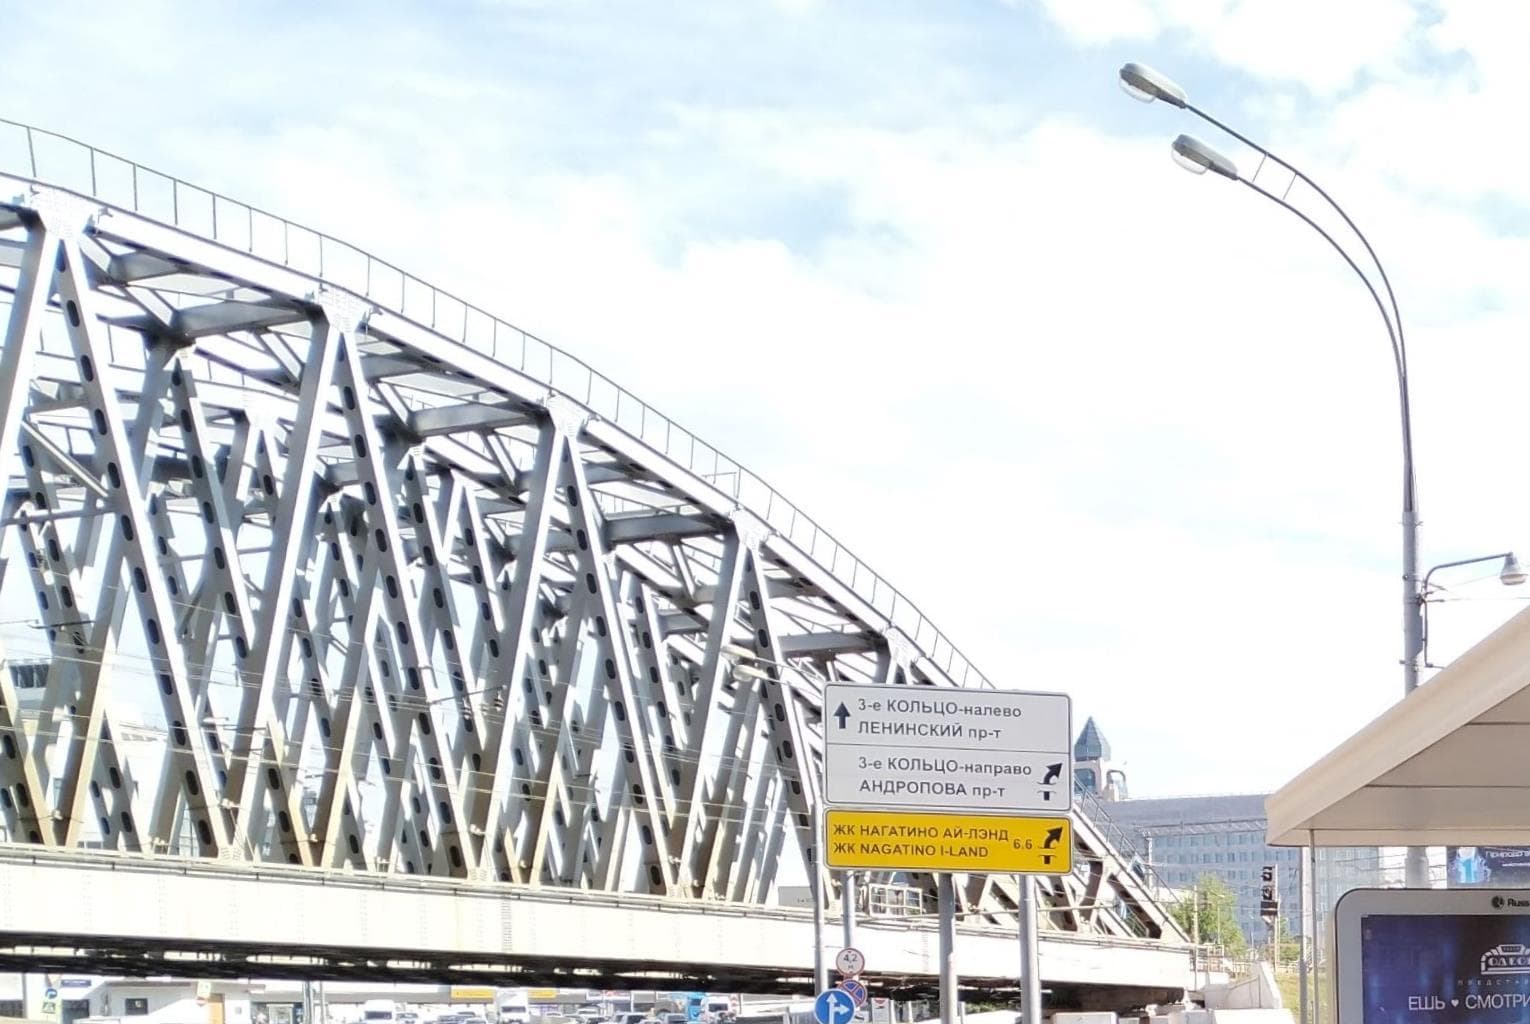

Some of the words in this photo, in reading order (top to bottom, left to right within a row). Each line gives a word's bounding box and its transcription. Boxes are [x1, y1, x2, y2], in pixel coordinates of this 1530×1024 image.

[858, 698, 881, 712] 3-е
[887, 699, 1021, 718] КОЛЬЦО-налево
[858, 721, 963, 738] ЛЕНИНСКИЙ
[969, 728, 1000, 740] пр-т
[858, 756, 882, 770] 3-е
[888, 757, 1032, 776] КОЛЬЦО-направо
[859, 780, 967, 796] АНДРОПОВА
[973, 786, 1005, 798] пр-т
[833, 824, 855, 836] ЖК
[860, 825, 938, 839] НАГАТИНО
[943, 825, 1009, 842] АЙ-ЛЭНД
[860, 844, 936, 856] NAGATINO
[940, 846, 989, 858] I-LAND
[1013, 838, 1033, 851] 6.6
[1408, 995, 1445, 1011] ЕШЬ
